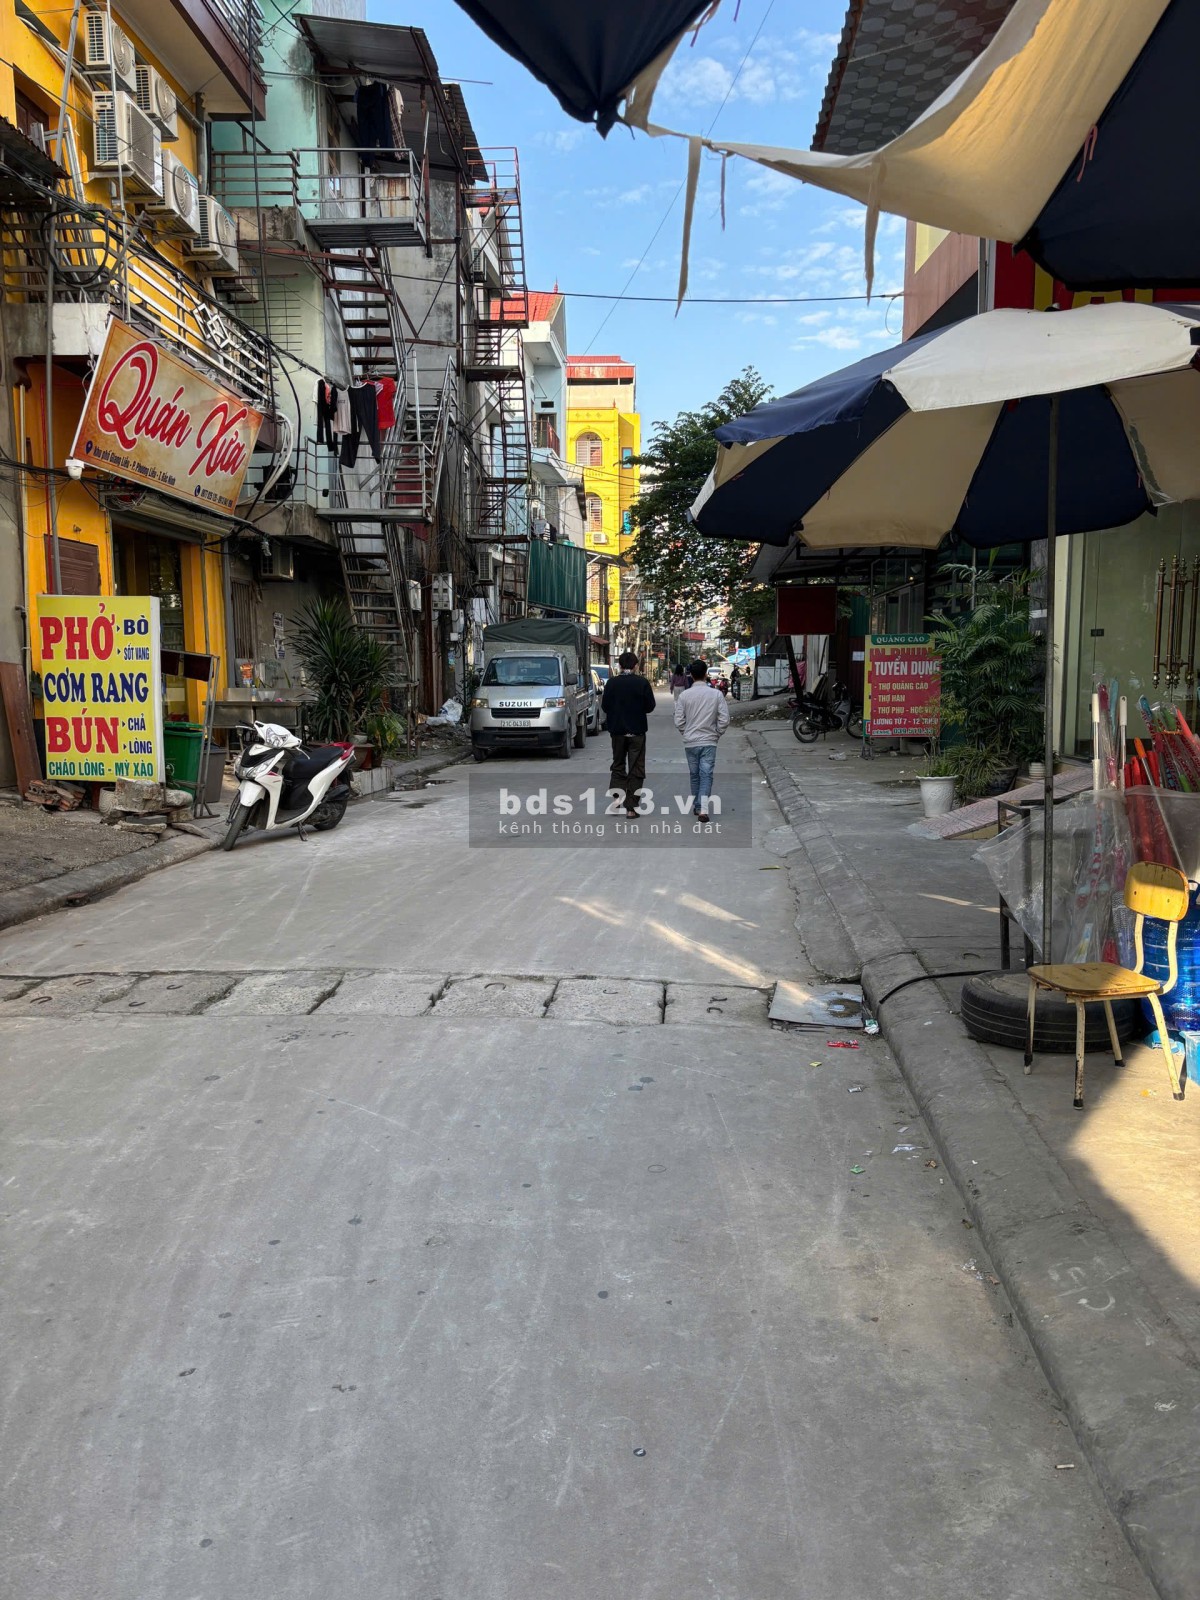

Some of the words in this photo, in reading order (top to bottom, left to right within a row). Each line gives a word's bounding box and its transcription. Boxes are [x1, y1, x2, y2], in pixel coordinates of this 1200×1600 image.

[97, 340, 194, 450] Quán
[189, 402, 248, 477] Xưa
[39, 603, 116, 661] PHỞ
[123, 615, 149, 636] BÒ
[123, 643, 134, 661] SỐT
[135, 647, 150, 661] VANG
[875, 656, 908, 676] TUYỂN
[911, 660, 940, 679] DỤNG
[44, 667, 87, 703] CƠM
[91, 672, 149, 703] RANG
[46, 708, 120, 754] BÚN
[128, 713, 146, 731] CHẢ
[129, 738, 152, 754] LÒNG
[48, 759, 76, 776] CHÁO
[78, 758, 105, 776] LÒNG
[115, 759, 130, 777] MỲ
[133, 759, 154, 777] XÀO
